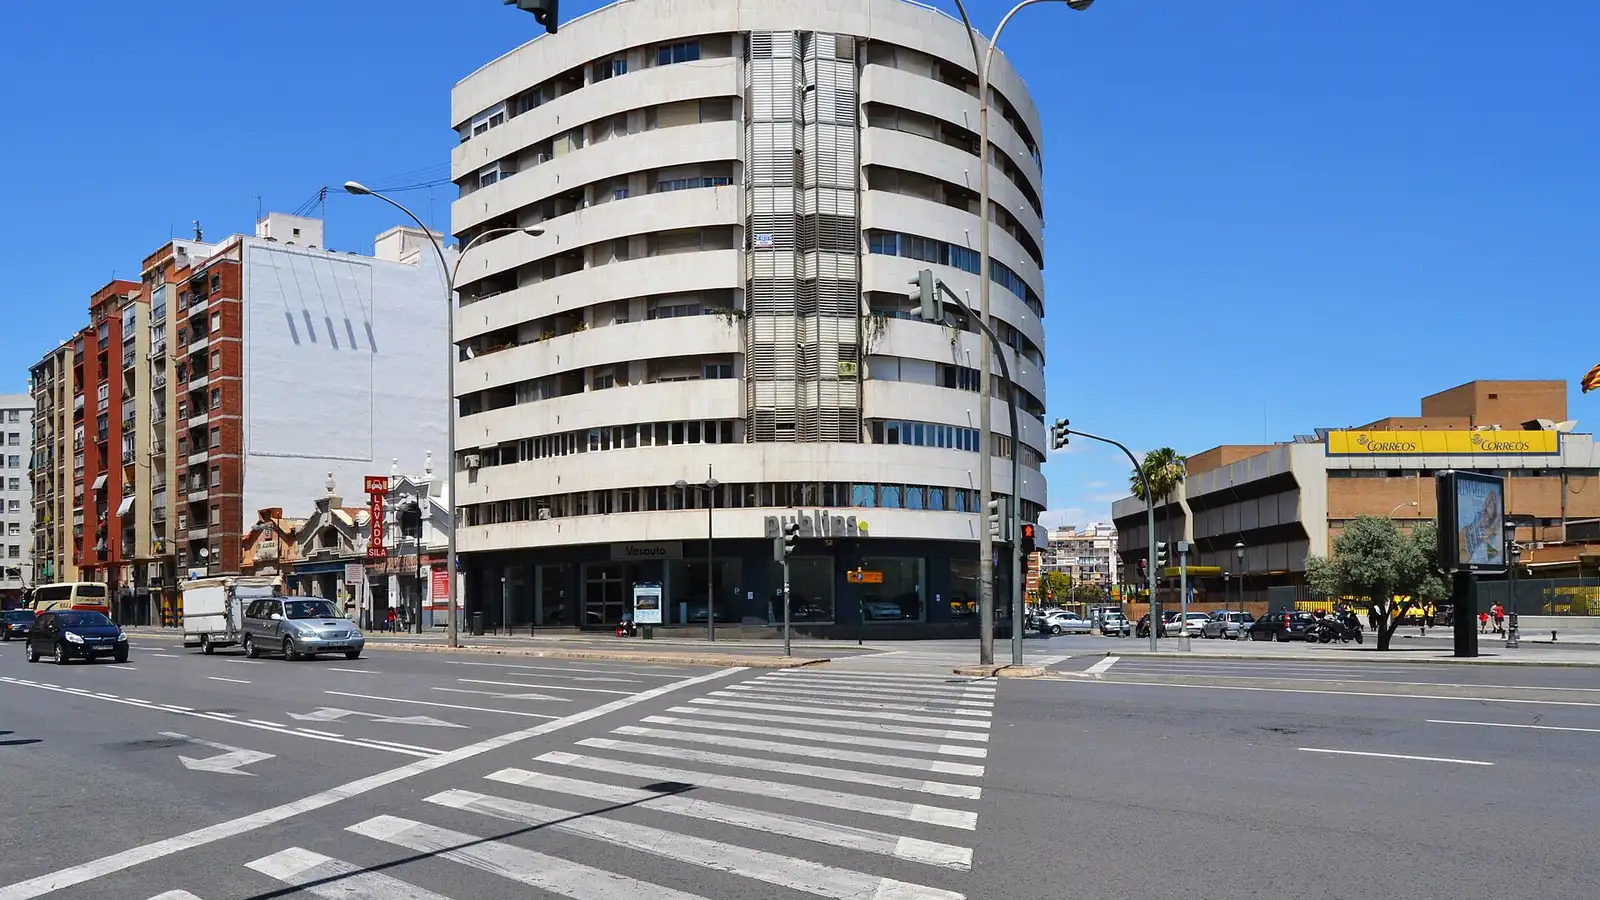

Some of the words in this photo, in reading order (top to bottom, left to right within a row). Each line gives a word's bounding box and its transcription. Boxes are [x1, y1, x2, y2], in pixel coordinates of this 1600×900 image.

[1367, 440, 1416, 452] CORREOS
[1481, 440, 1529, 452] CORREOS
[369, 549, 386, 557] SILA
[626, 545, 666, 556] Vasauto
